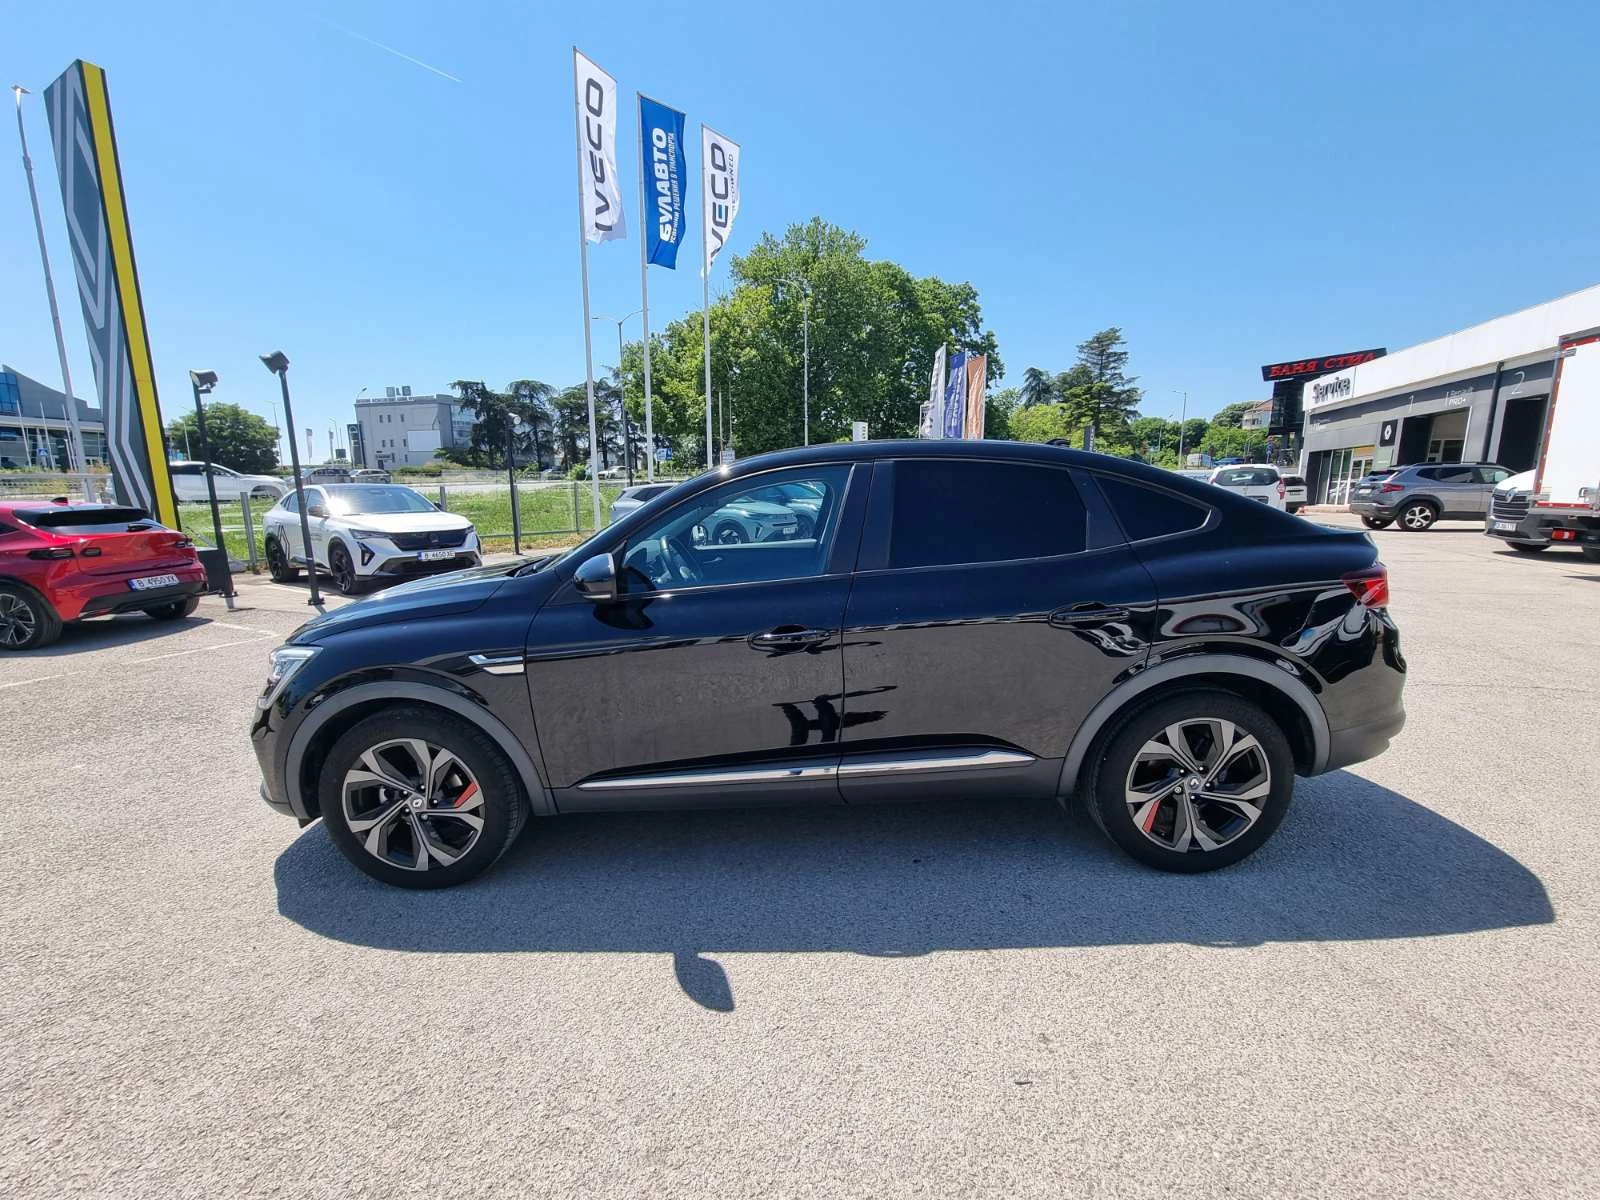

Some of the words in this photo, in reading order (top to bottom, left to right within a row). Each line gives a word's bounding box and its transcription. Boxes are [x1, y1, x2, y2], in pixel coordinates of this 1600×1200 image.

[586, 77, 613, 232] IVECO
[652, 127, 673, 242] БУЛАВТО
[710, 142, 728, 264] VECO
[1312, 376, 1351, 402] Service
[1511, 370, 1526, 395] 2
